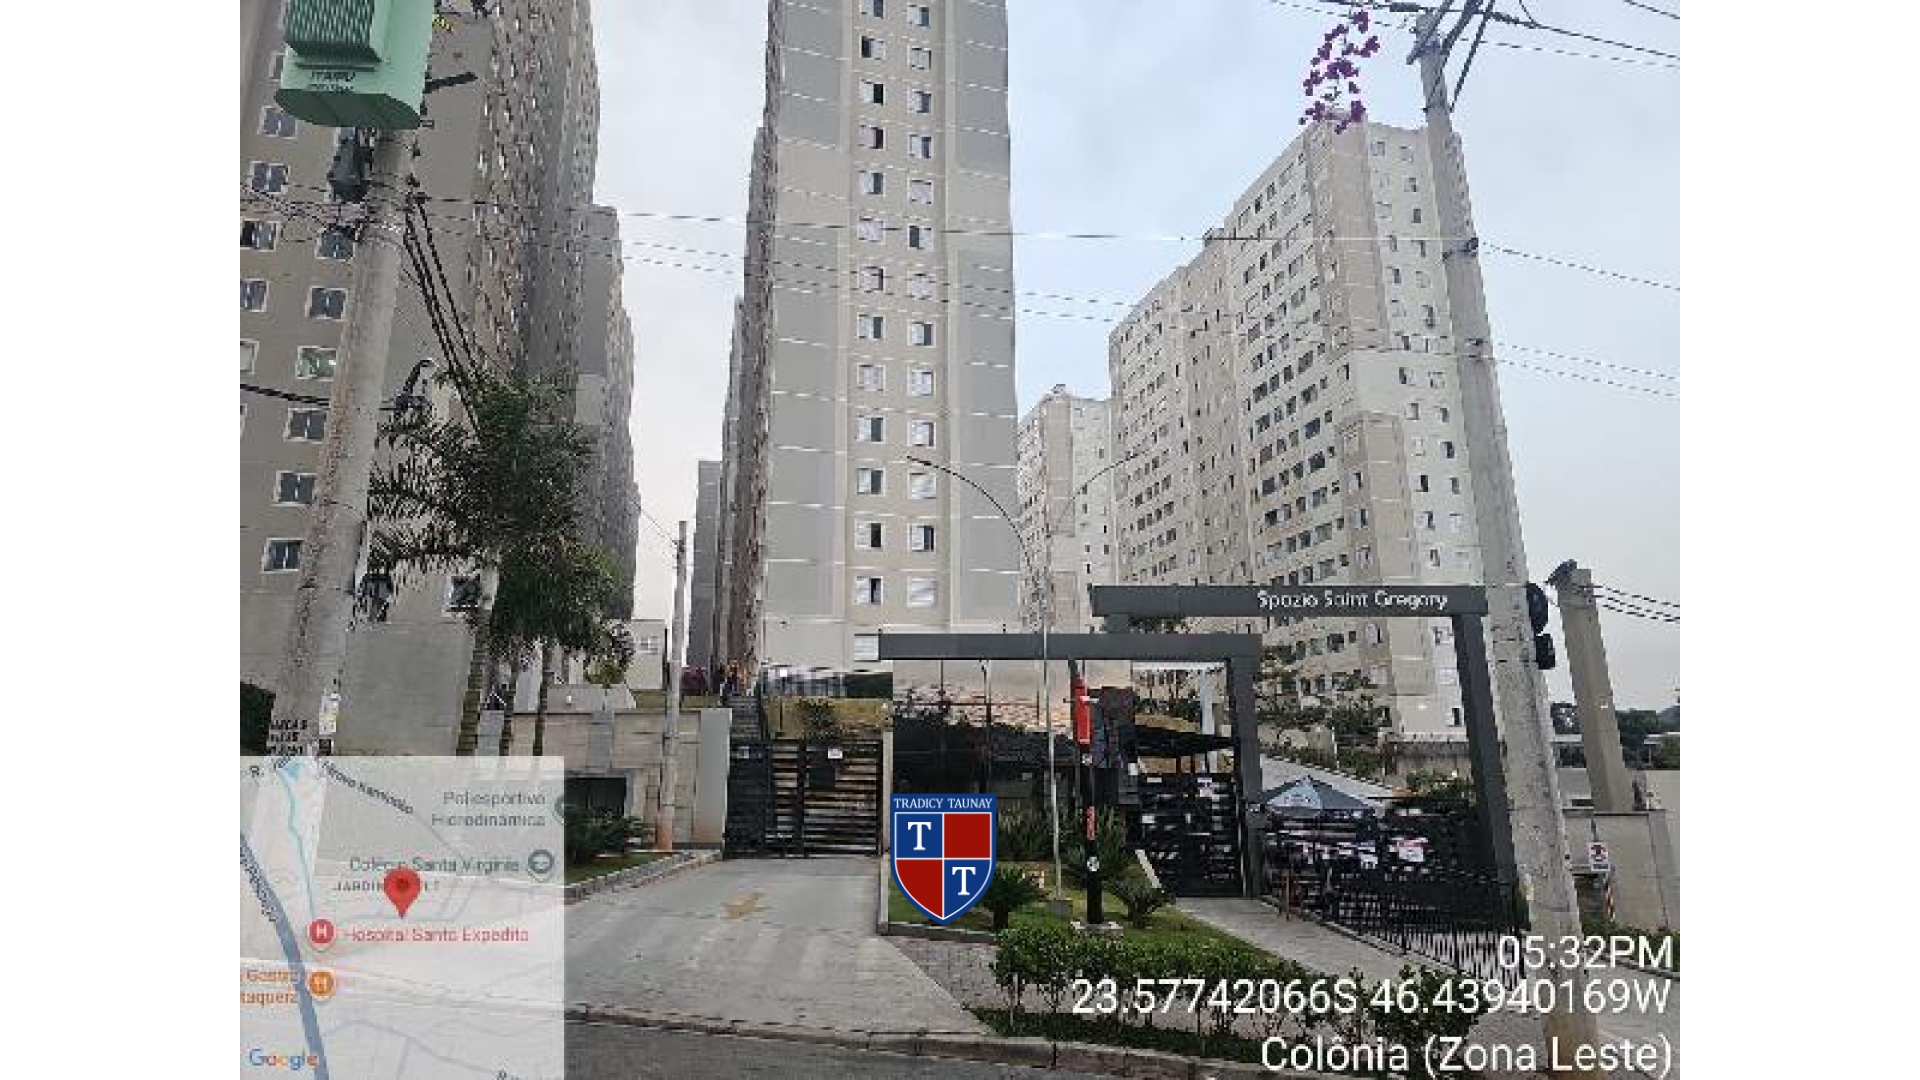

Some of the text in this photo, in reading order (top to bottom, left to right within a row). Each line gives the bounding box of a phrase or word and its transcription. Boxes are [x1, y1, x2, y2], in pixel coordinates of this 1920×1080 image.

[1257, 590, 1448, 610] Spazio Saint Gregory
